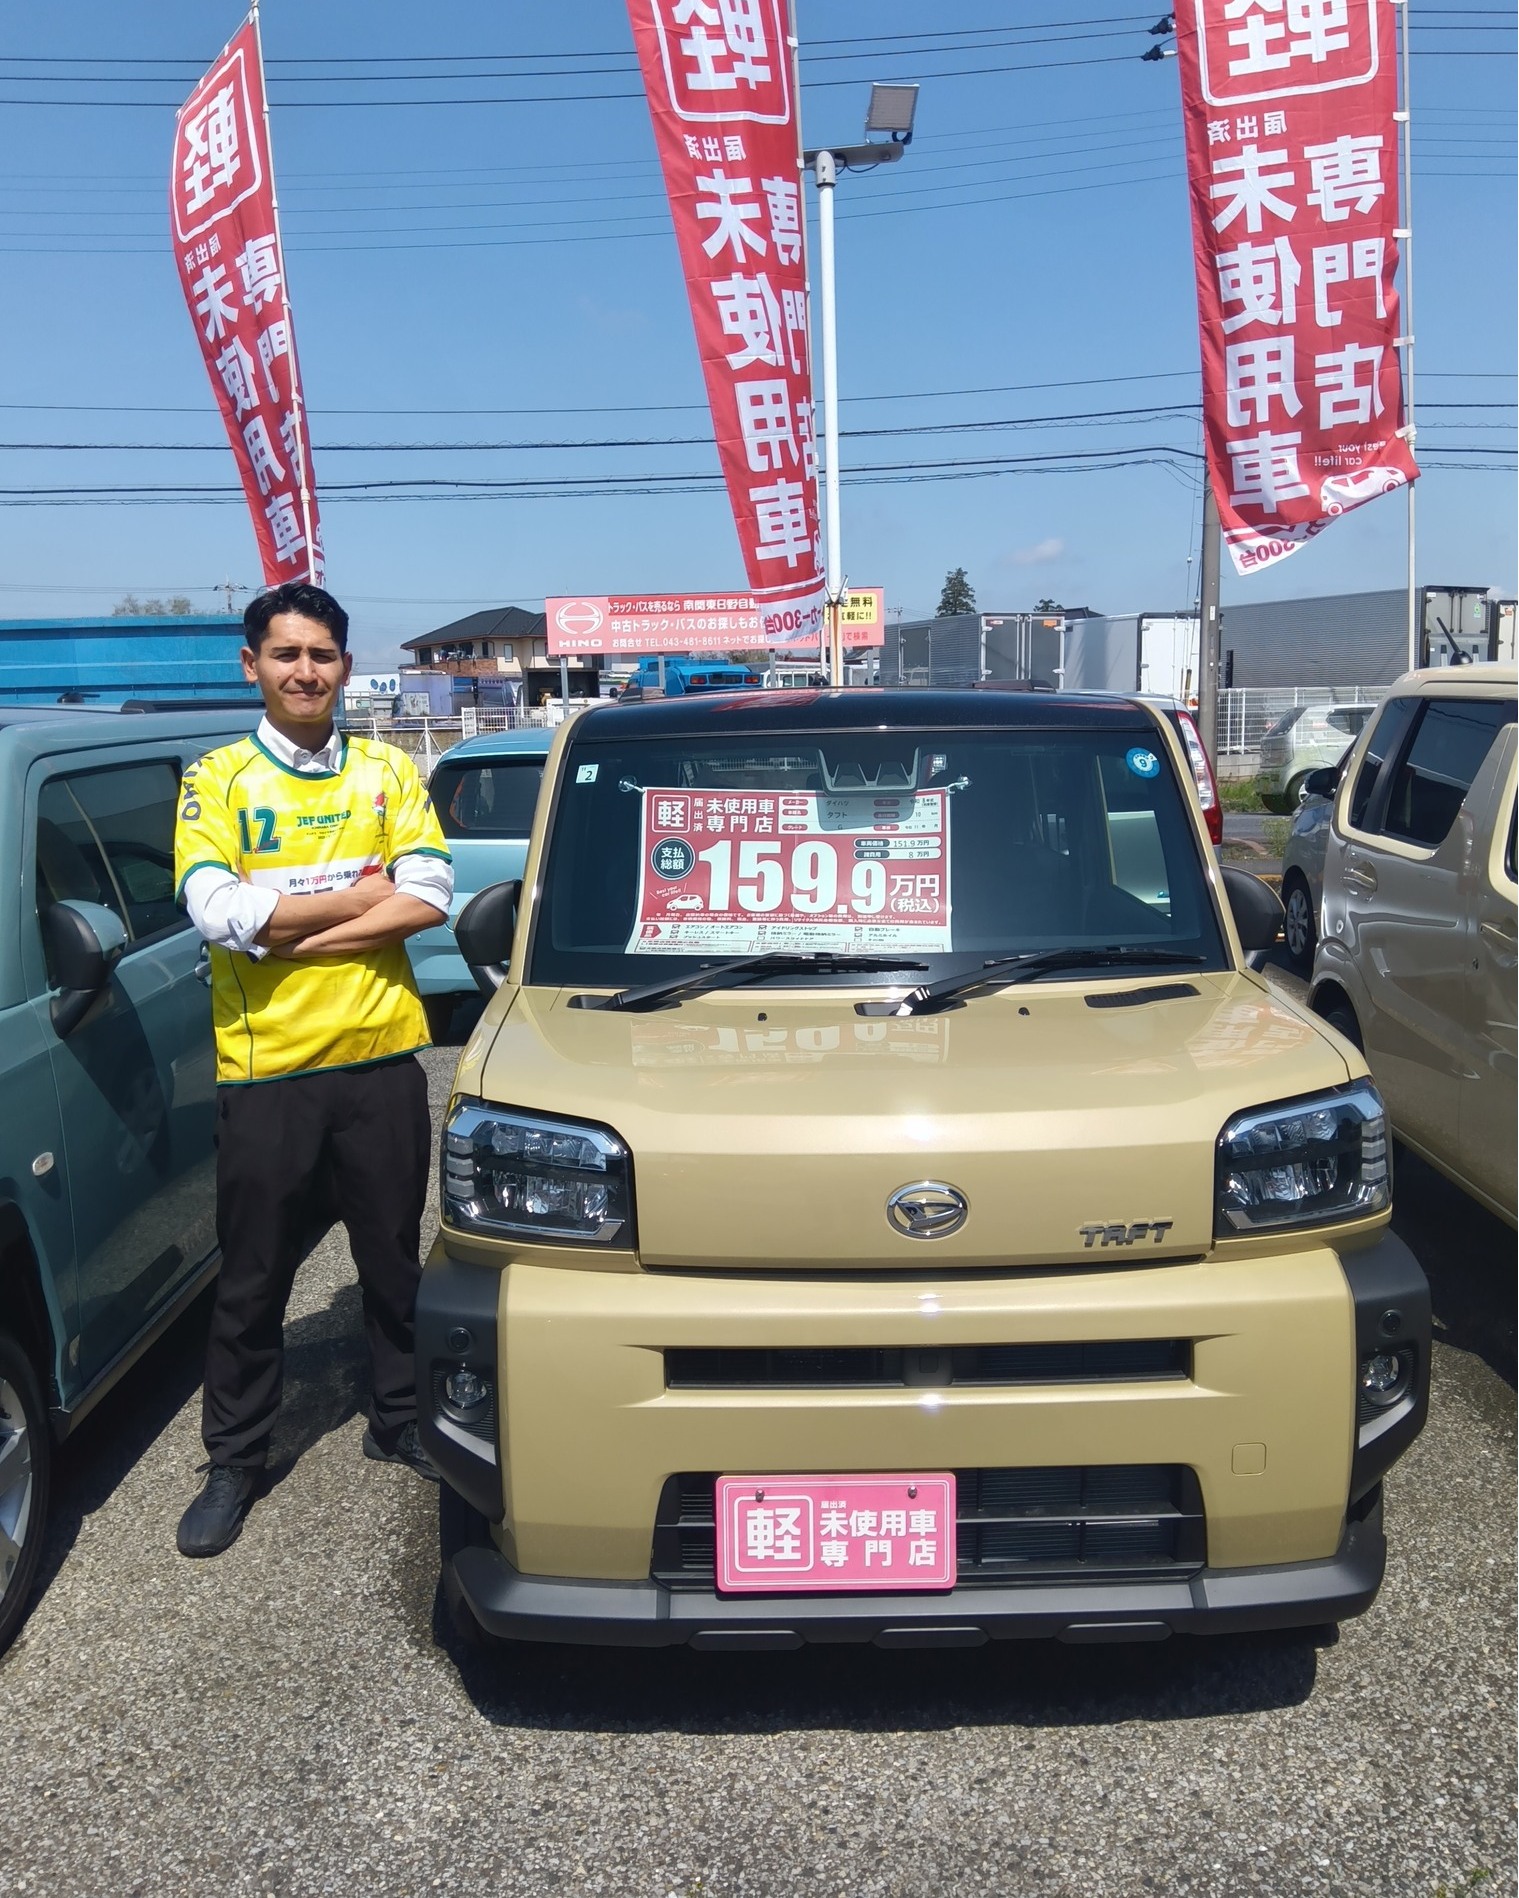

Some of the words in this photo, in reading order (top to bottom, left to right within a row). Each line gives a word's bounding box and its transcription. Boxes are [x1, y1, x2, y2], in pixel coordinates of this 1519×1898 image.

[558, 638, 603, 648] HINO
[584, 770, 593, 781] 2
[657, 800, 686, 828] 軽
[706, 797, 775, 815] 未使用車
[296, 815, 316, 827] JEF
[317, 809, 352, 824] UNITED
[236, 806, 282, 856] 12
[661, 847, 685, 859] 支払
[893, 840, 916, 848] 151.9
[660, 859, 685, 870] 総額
[698, 839, 887, 914] 159.9
[890, 874, 940, 898] 万円
[890, 897, 940, 914] (税込)
[1079, 1216, 1173, 1248] TAFT
[819, 1508, 938, 1538] 未使用車
[746, 1507, 802, 1560] 軽
